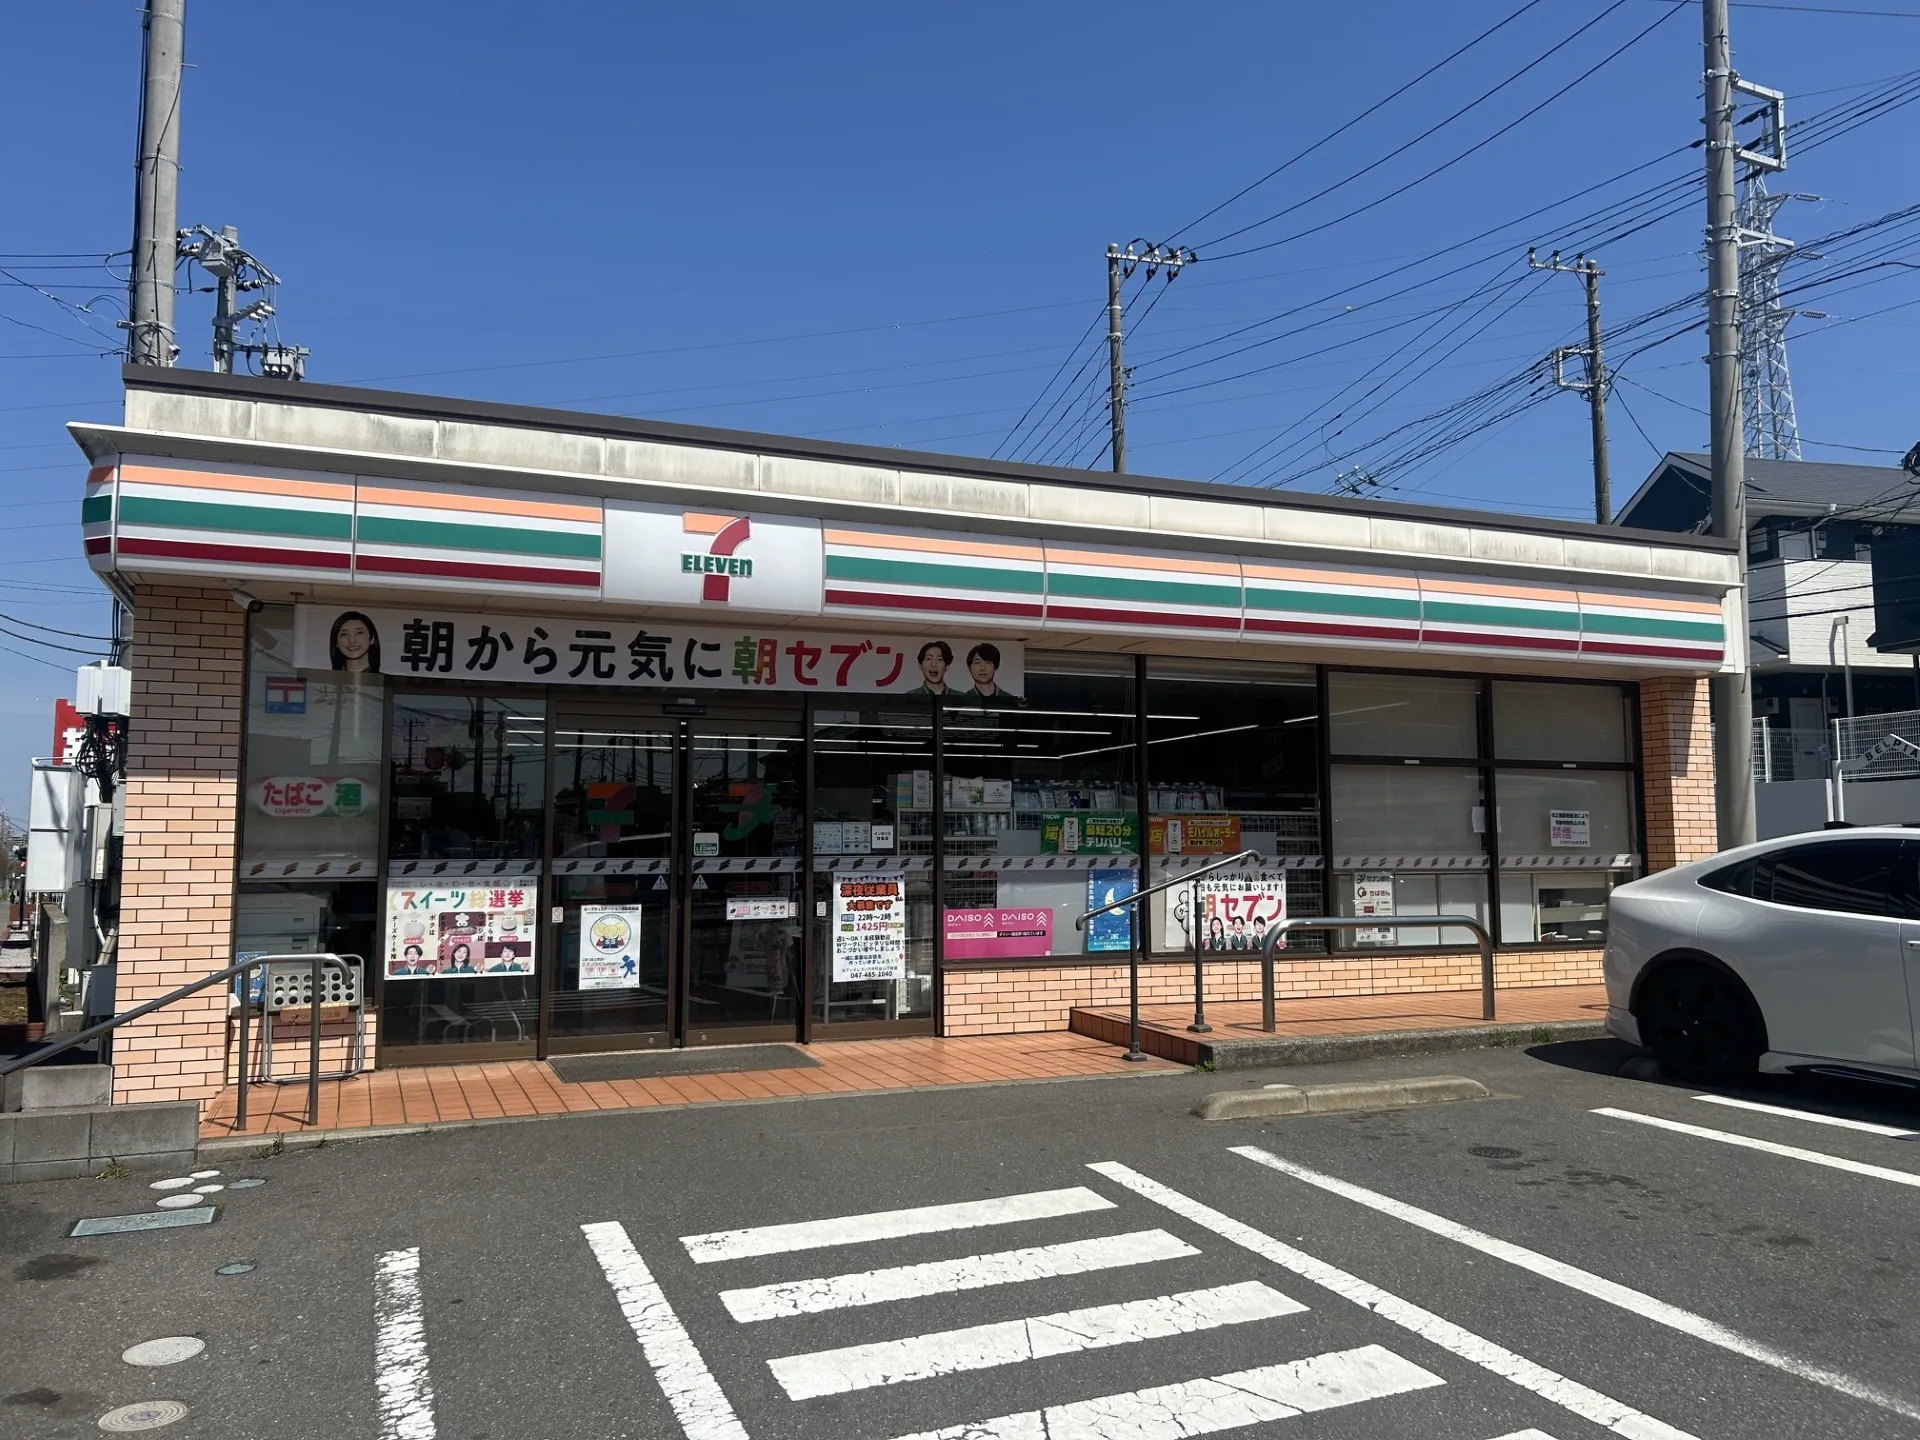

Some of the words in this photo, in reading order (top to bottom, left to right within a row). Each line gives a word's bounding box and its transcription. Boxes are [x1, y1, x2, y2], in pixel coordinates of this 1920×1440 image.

[683, 512, 751, 601] 7
[400, 618, 904, 687] 朝から元気に朝セブン
[1865, 739, 1918, 761] BELPIA
[263, 782, 324, 806] たばこ
[335, 783, 362, 806] 酒
[1086, 825, 1131, 836] 最短20分
[1086, 837, 1131, 847] デリバリー
[840, 882, 899, 898] 深夜従業員
[401, 890, 524, 910] スイーツ総選挙
[947, 914, 982, 922] DAISO
[1001, 912, 1035, 920] DAISO
[856, 922, 888, 932] 1425円
[850, 970, 893, 979] 047-485-1040
